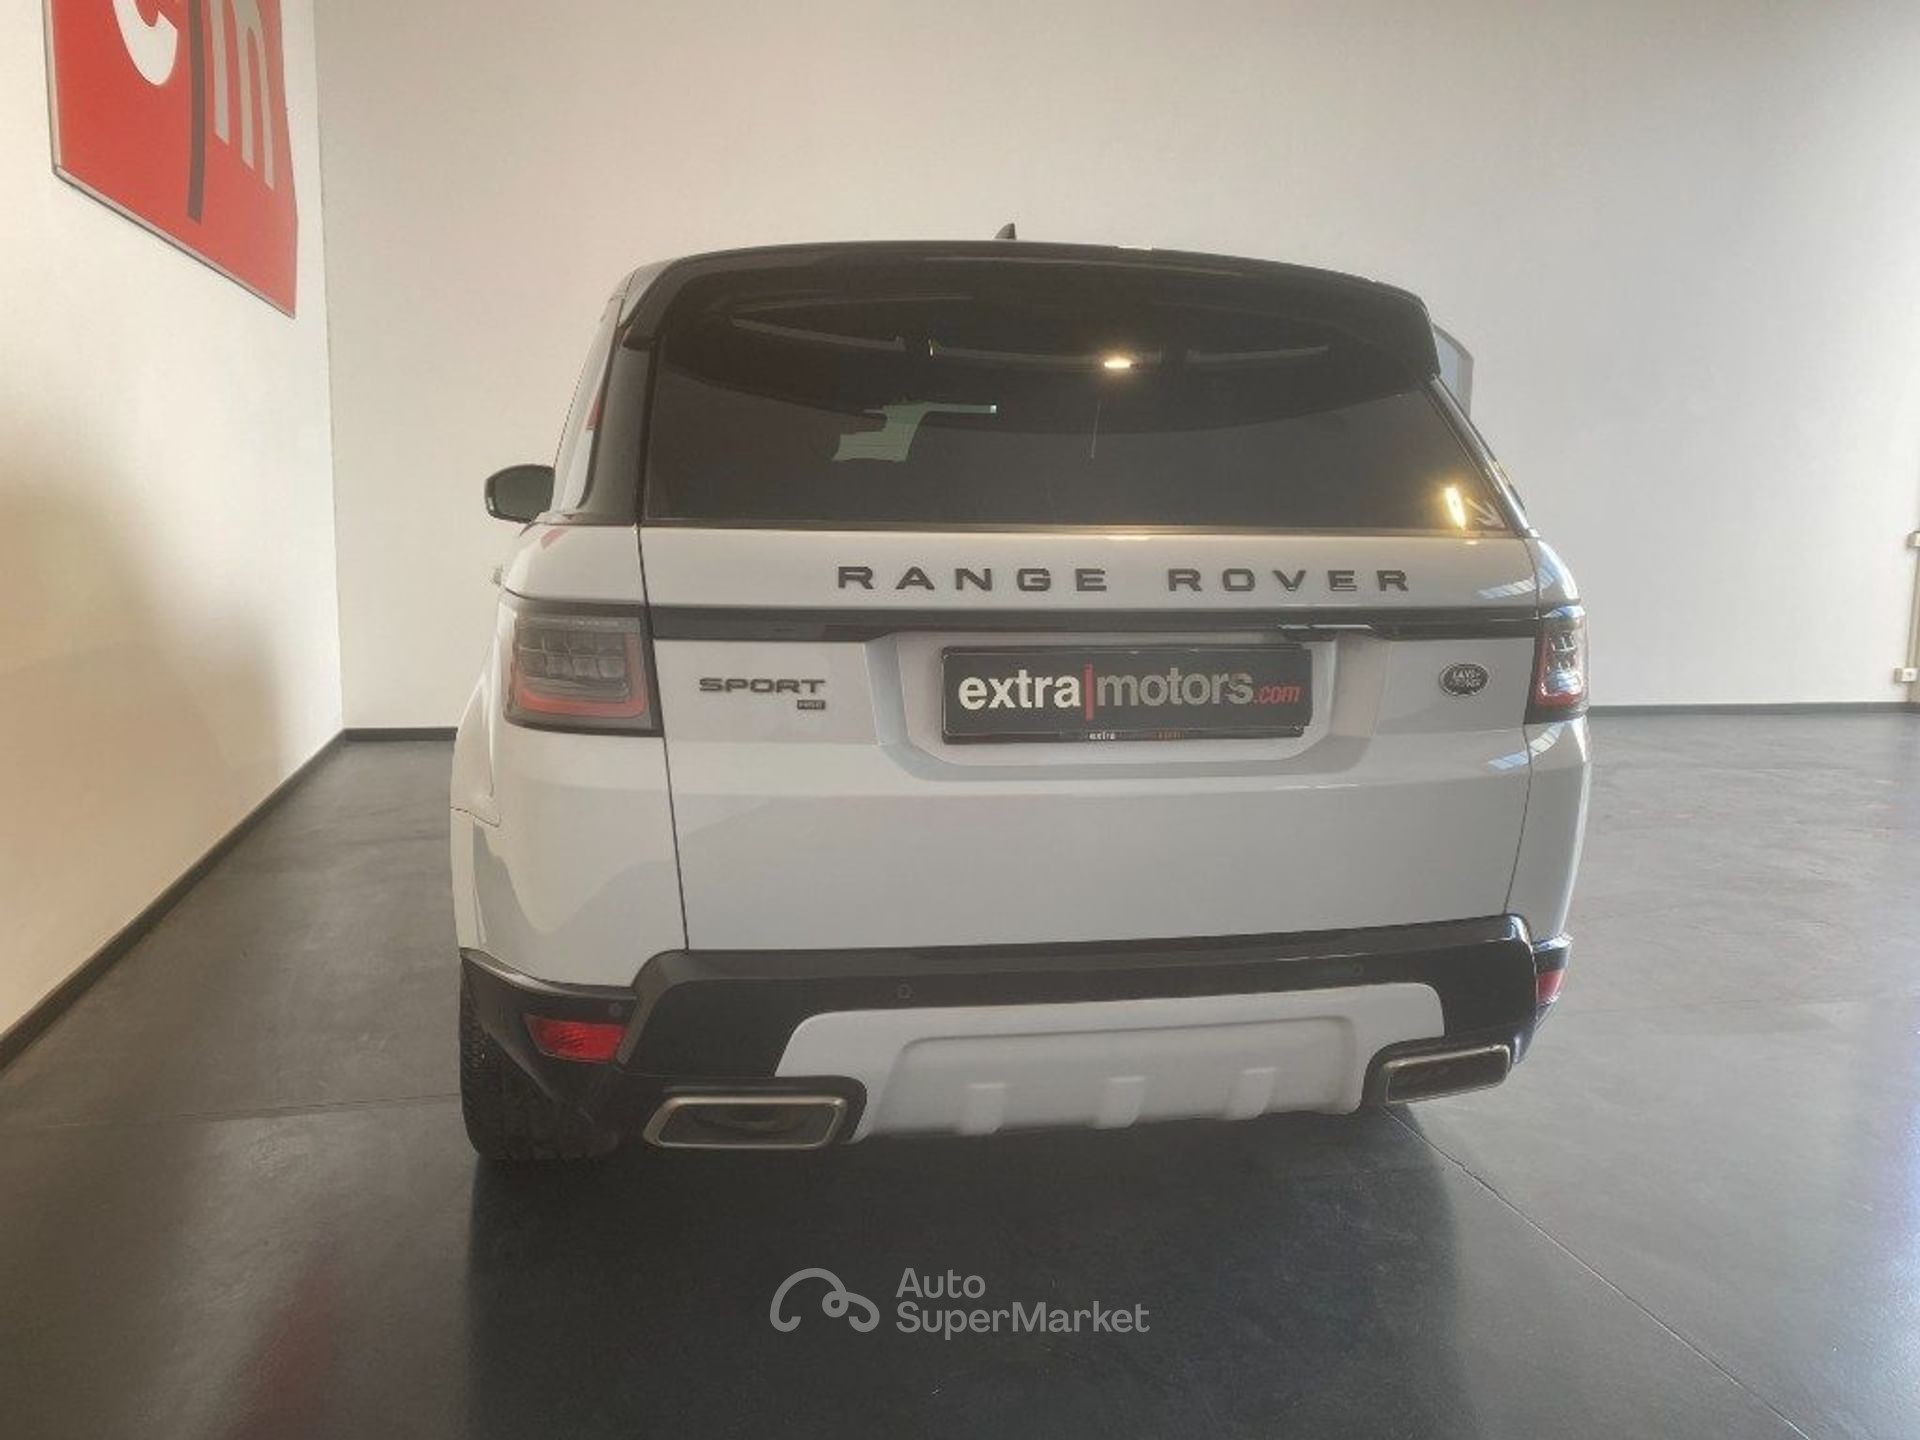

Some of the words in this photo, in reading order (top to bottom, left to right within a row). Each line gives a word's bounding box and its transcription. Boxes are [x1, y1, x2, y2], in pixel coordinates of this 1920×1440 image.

[837, 565, 1108, 592] RANGE
[1167, 567, 1410, 593] ROVER
[699, 677, 826, 693] SPORT
[957, 668, 1081, 710] extra
